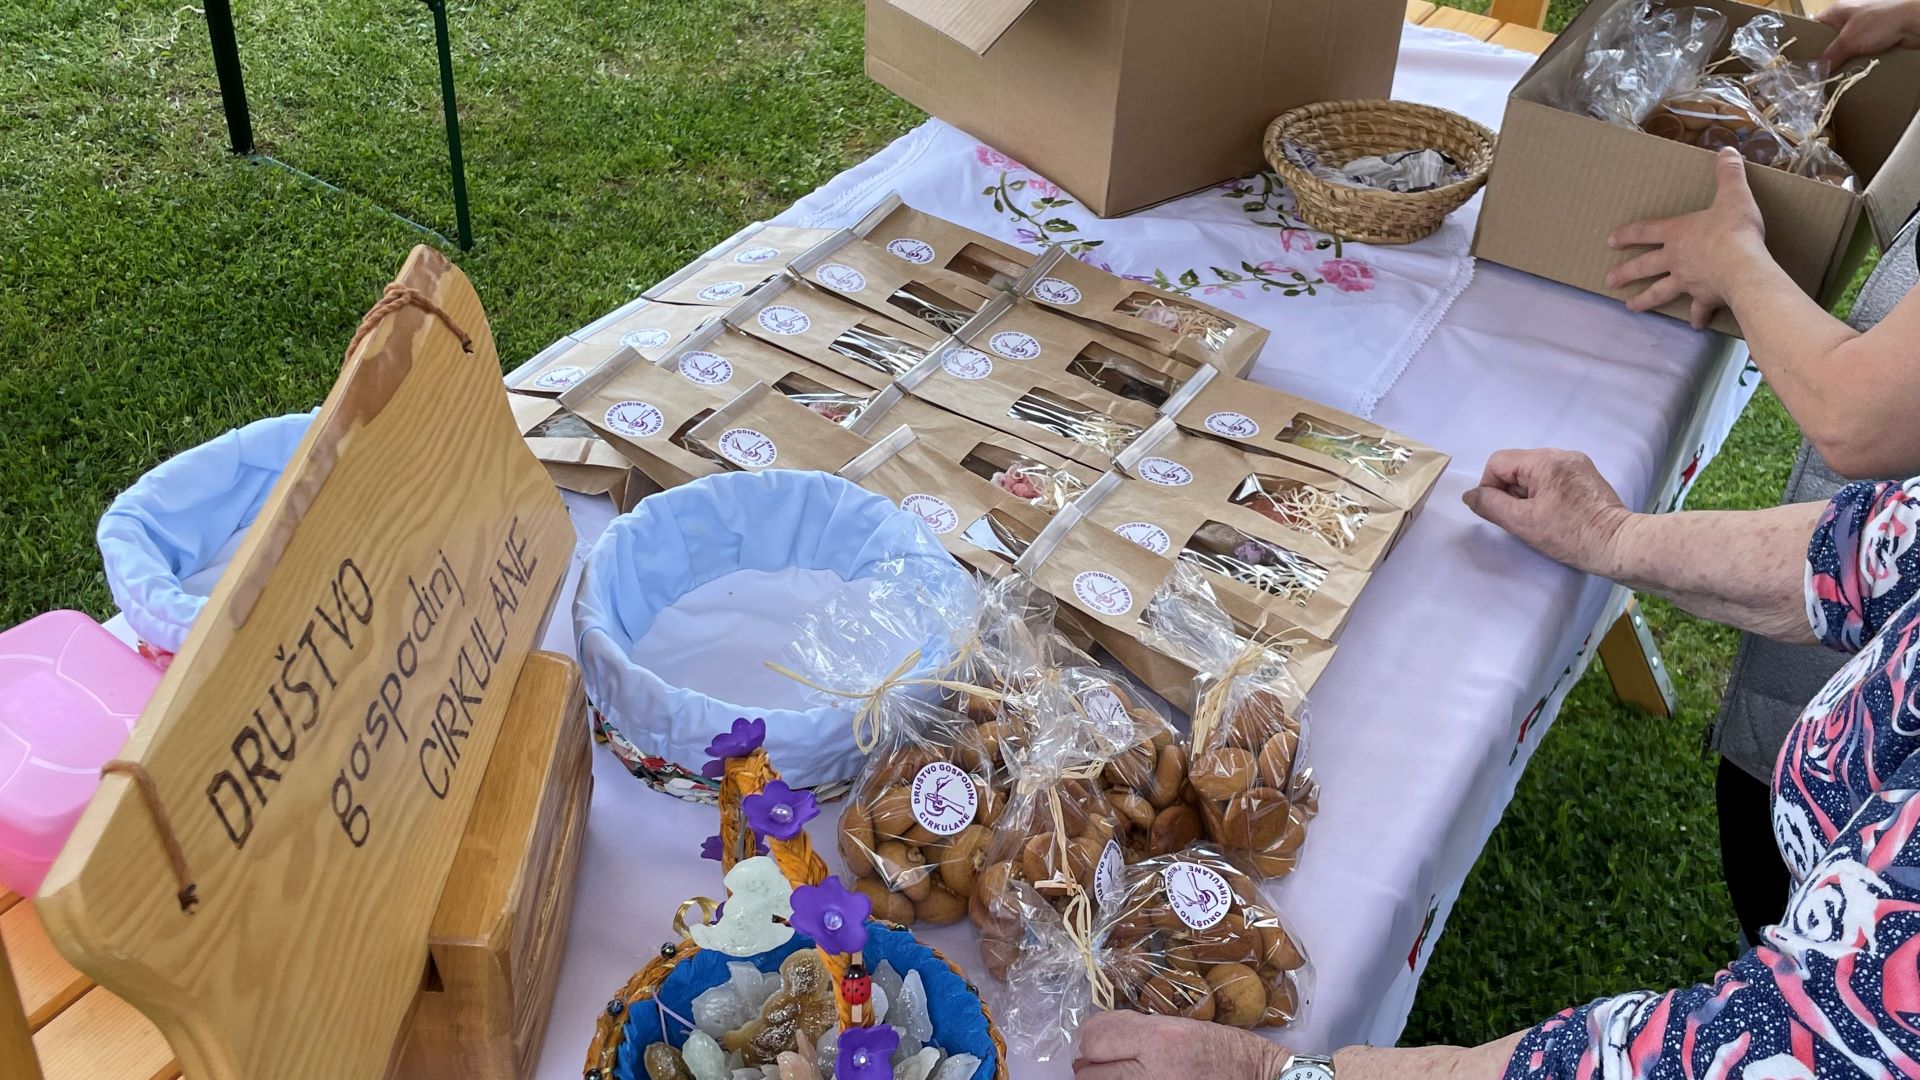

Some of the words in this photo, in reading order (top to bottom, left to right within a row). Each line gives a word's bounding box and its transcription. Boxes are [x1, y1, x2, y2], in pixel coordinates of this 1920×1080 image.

[420, 516, 538, 799] CIRKULANE
[206, 558, 374, 850] DRUŠTVO
[332, 550, 466, 847] gospodinj
[914, 765, 937, 804] DRUŠTVO
[939, 764, 974, 806] GOSPODINJ
[919, 812, 970, 832] CIRKULANE
[1188, 865, 1227, 905] CIRKULANE
[1180, 910, 1221, 928] DRUŠTVO
